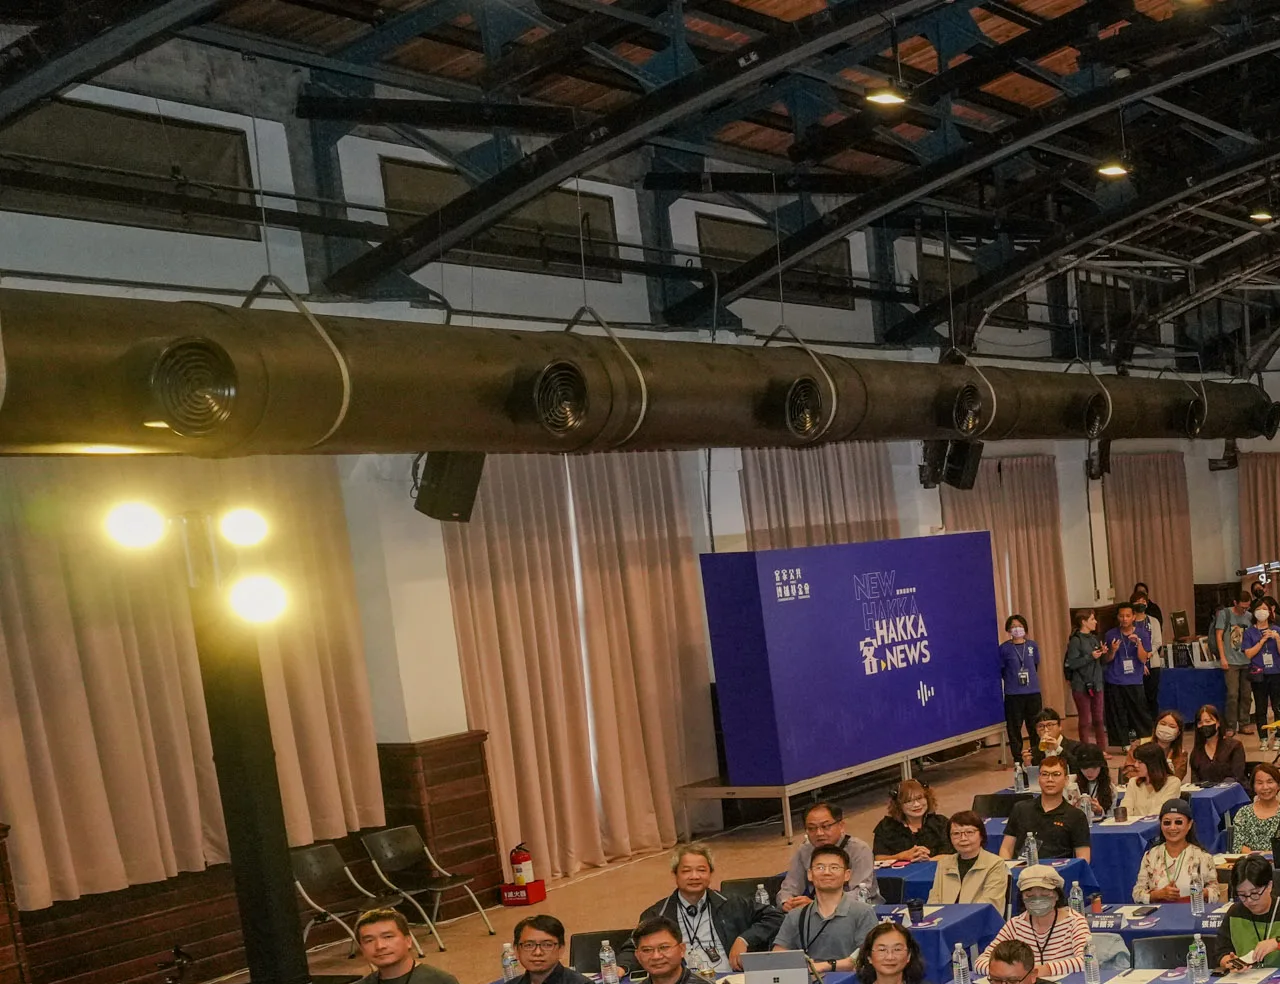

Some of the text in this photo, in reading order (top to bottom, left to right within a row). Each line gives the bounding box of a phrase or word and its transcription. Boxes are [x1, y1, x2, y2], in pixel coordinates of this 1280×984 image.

[853, 570, 896, 600] NEW
[874, 613, 928, 645] HAKKA
[885, 640, 931, 670] NEWS
